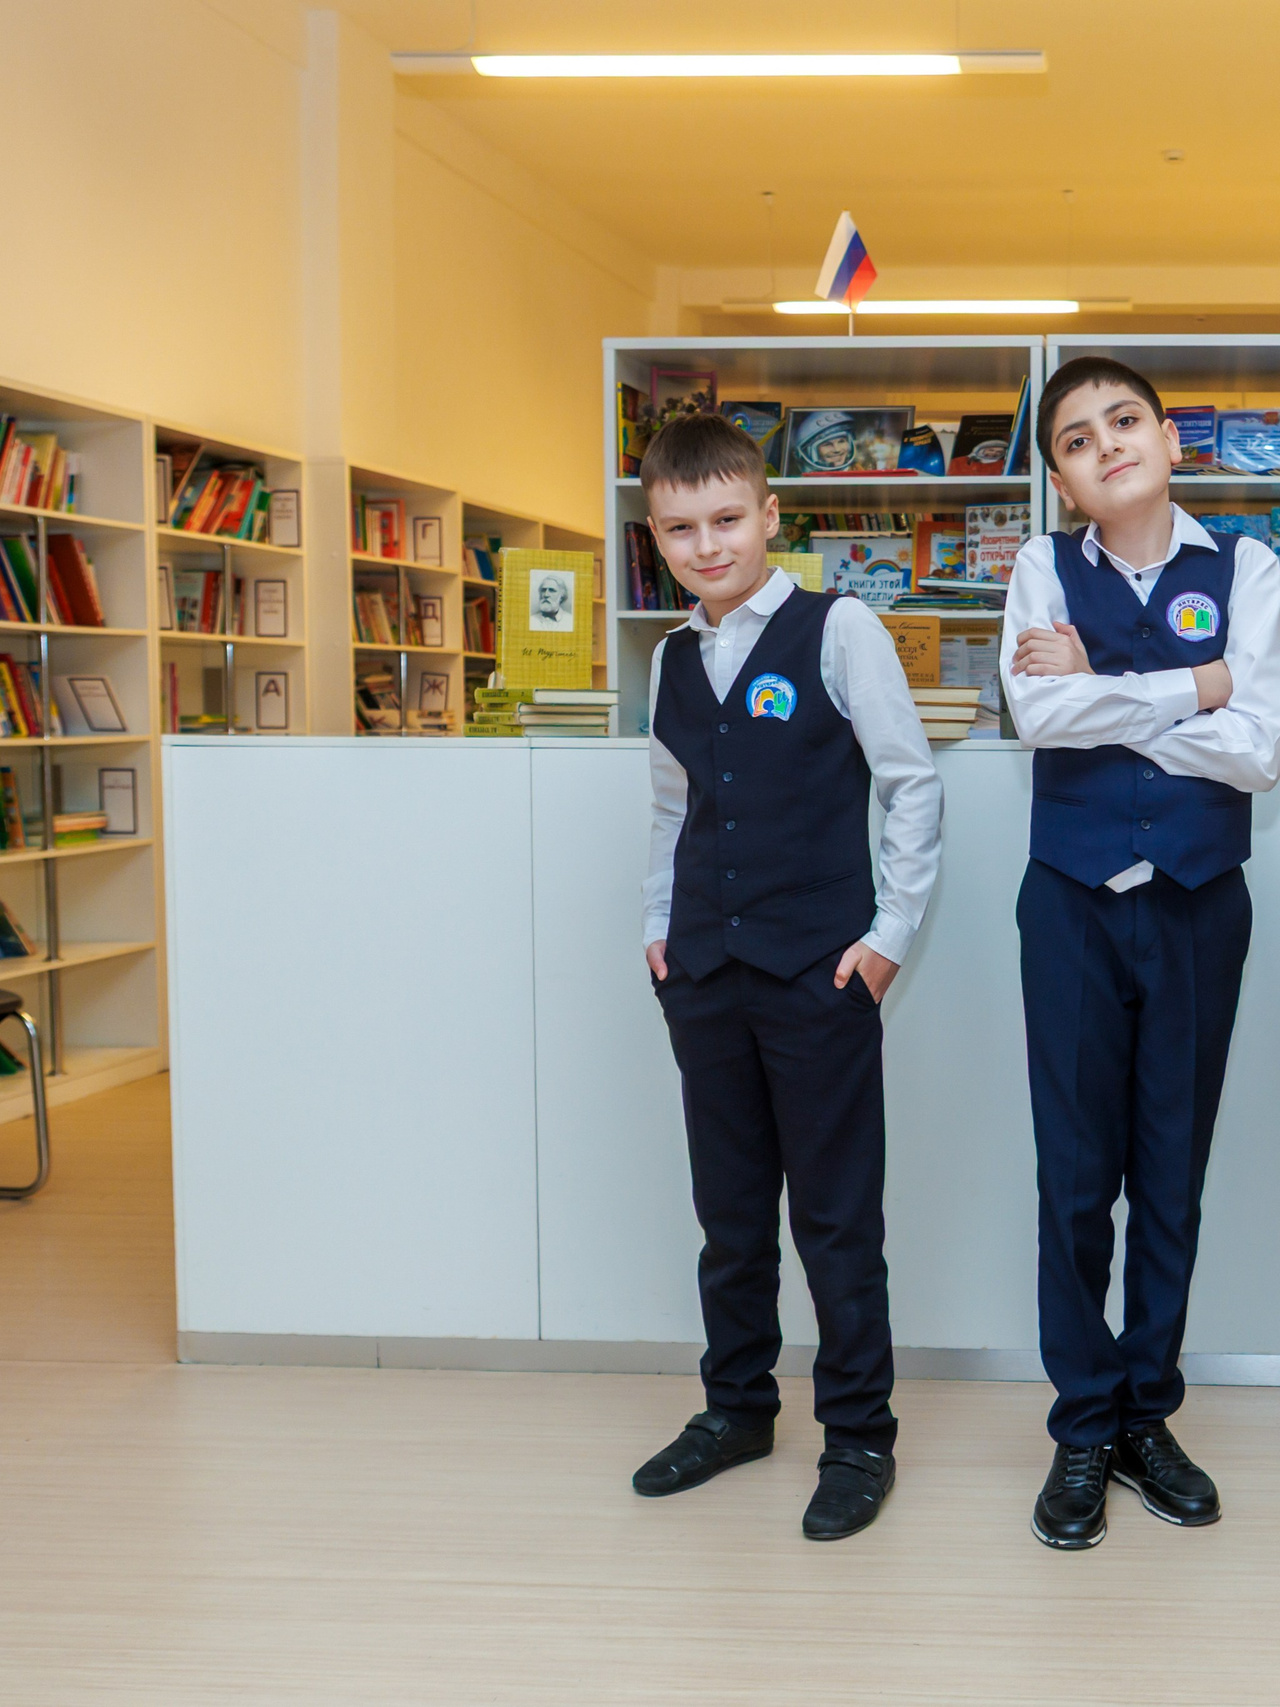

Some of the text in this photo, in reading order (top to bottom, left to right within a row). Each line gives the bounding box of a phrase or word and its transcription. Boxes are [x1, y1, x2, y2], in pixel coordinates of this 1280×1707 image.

[980, 550, 1019, 562] ОТКРЫТИ
[848, 578, 901, 589] КНИГИ ЭТОЙ
[861, 592, 894, 601] НЕДЕЛИ
[262, 679, 280, 697] А
[423, 678, 444, 695] Ж
